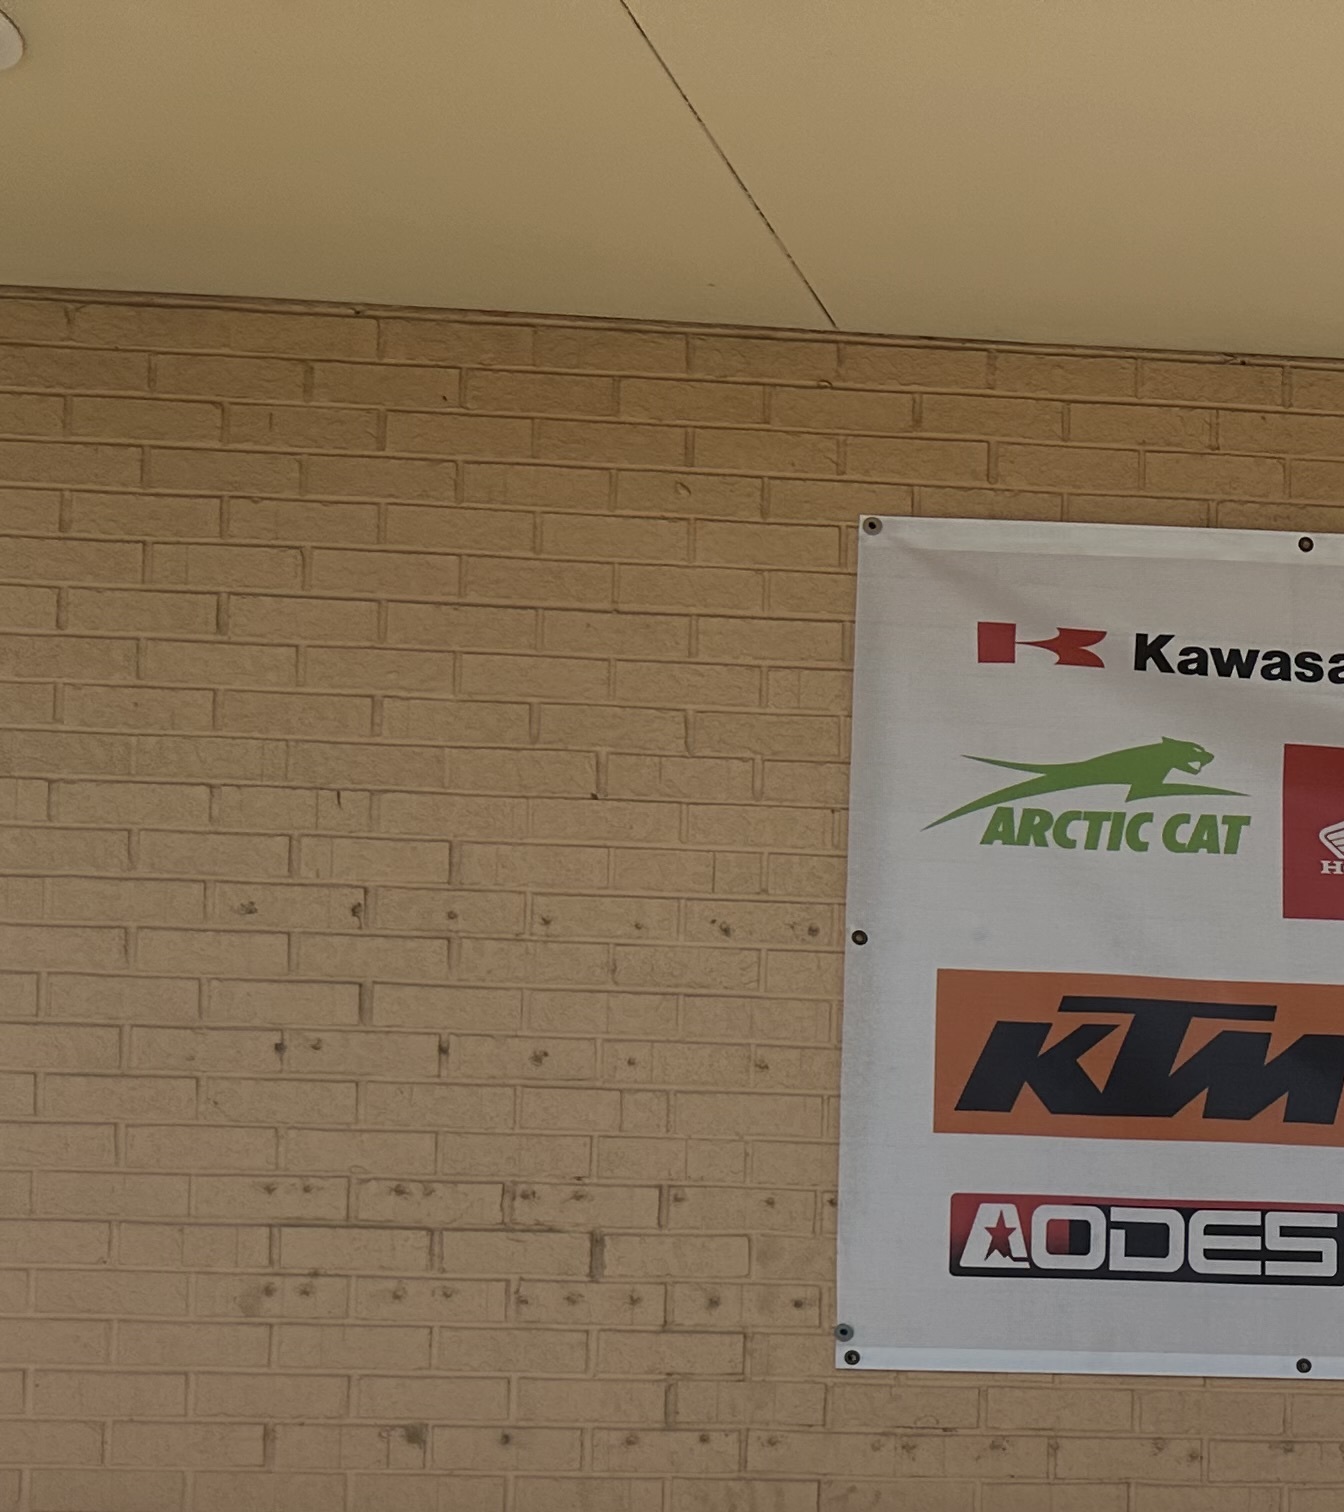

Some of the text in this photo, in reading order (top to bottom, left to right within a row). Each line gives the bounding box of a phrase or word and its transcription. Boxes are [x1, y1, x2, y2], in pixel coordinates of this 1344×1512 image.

[979, 806, 1252, 856] ARCTIC CAT
[958, 1203, 1339, 1278] AODES
